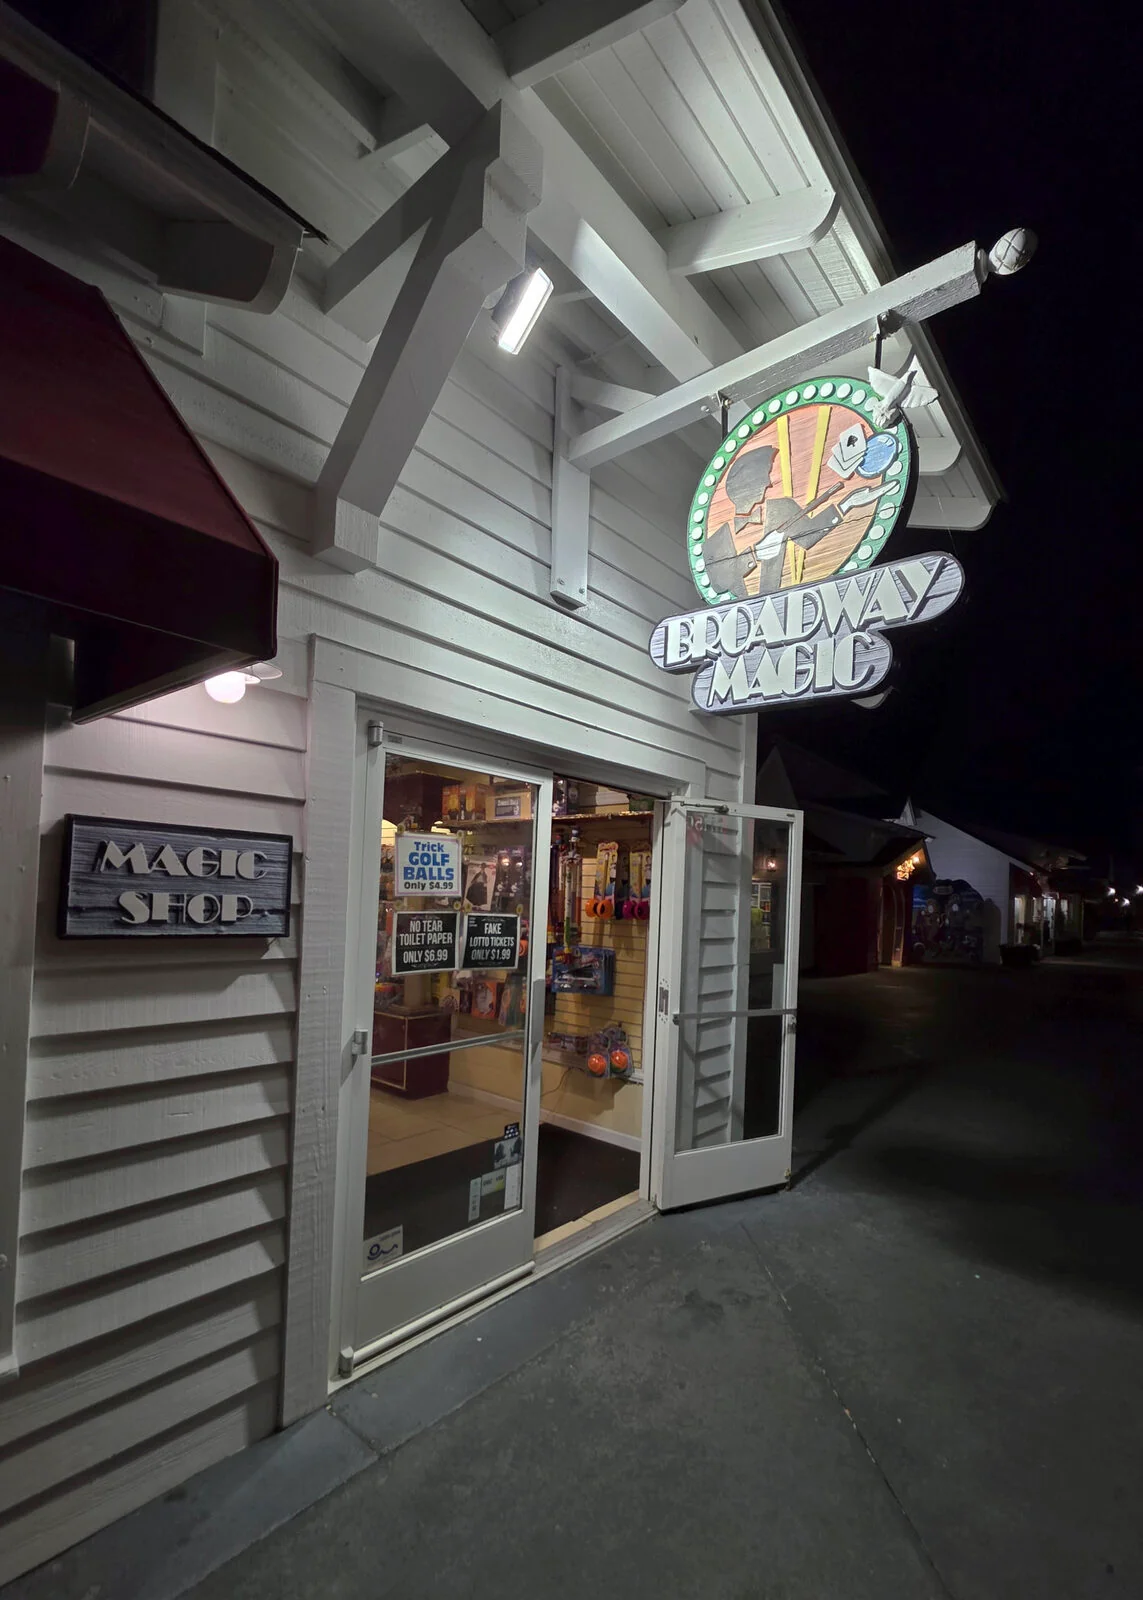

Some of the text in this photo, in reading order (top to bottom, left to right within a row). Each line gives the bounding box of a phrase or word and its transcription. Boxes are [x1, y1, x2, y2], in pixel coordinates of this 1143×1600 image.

[666, 556, 947, 665] BROADWAY
[708, 632, 875, 707] MAGIC
[414, 841, 444, 852] Trick
[98, 840, 268, 880] MAGIC
[408, 852, 450, 866] GOLF
[403, 866, 454, 881] BALLS
[404, 881, 453, 891] Only $4.99
[118, 890, 254, 924] SHOP
[409, 920, 443, 932] NO TEAR
[484, 923, 502, 934] FAKE
[400, 932, 453, 946] TOILET PAPER
[470, 937, 514, 947] LOTTO TICKETS
[403, 949, 448, 963] ONLY $6.99
[471, 948, 511, 960] ONLY $1.99
